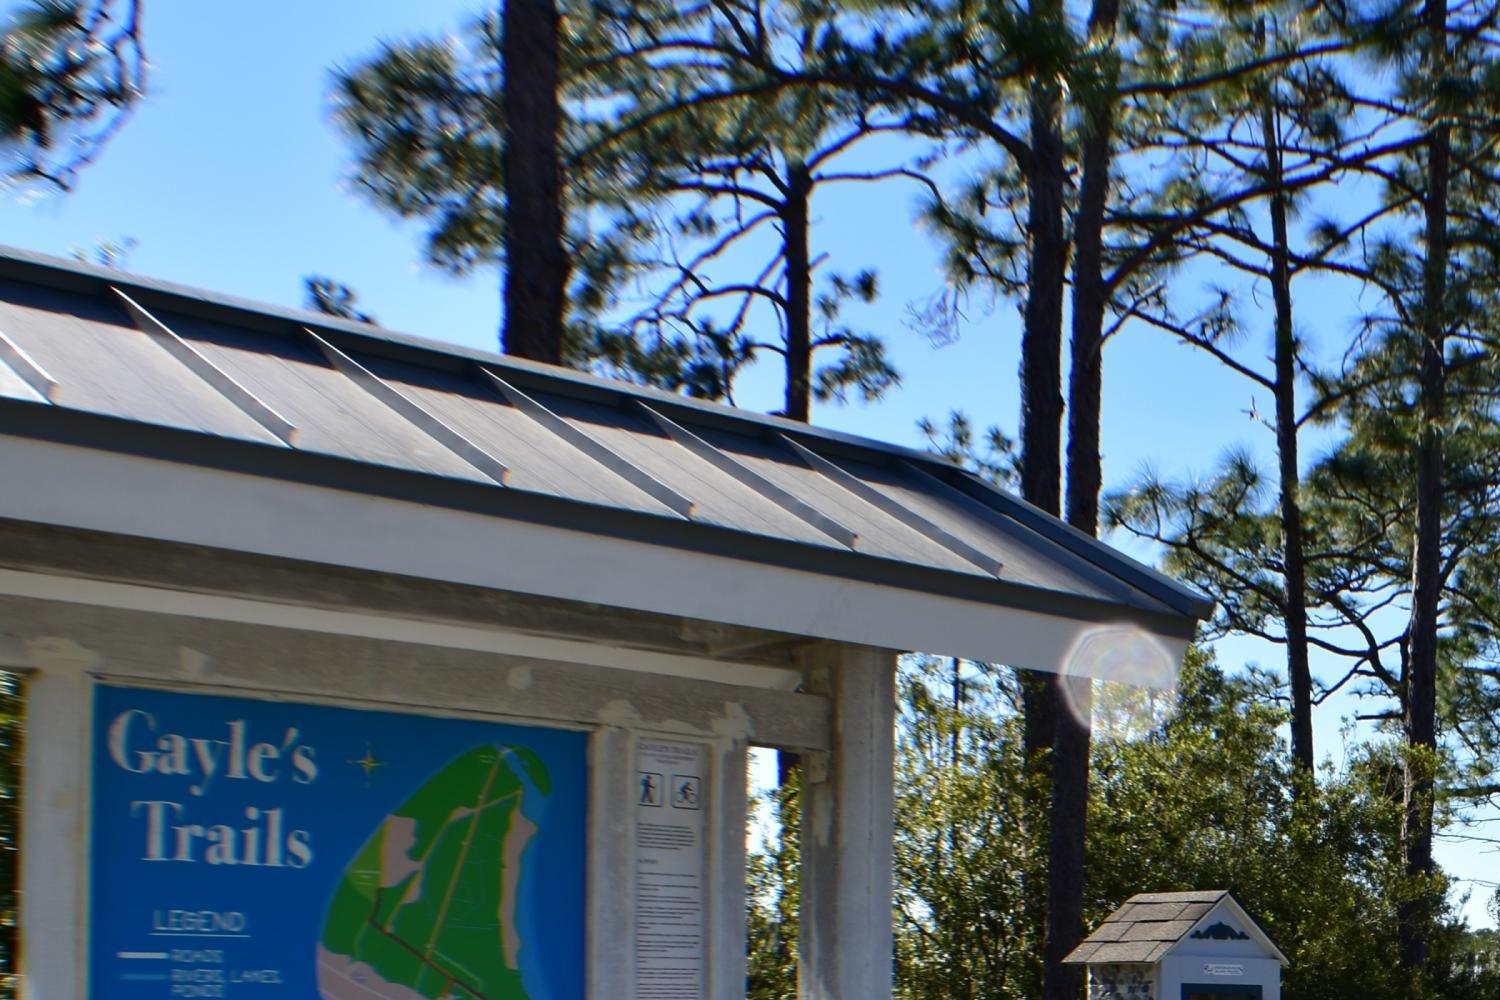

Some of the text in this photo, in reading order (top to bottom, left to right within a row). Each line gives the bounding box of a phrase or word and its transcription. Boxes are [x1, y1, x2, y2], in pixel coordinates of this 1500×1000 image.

[108, 709, 317, 795] Gayle's
[130, 800, 312, 869] Trails
[153, 909, 246, 931] LEGEND
